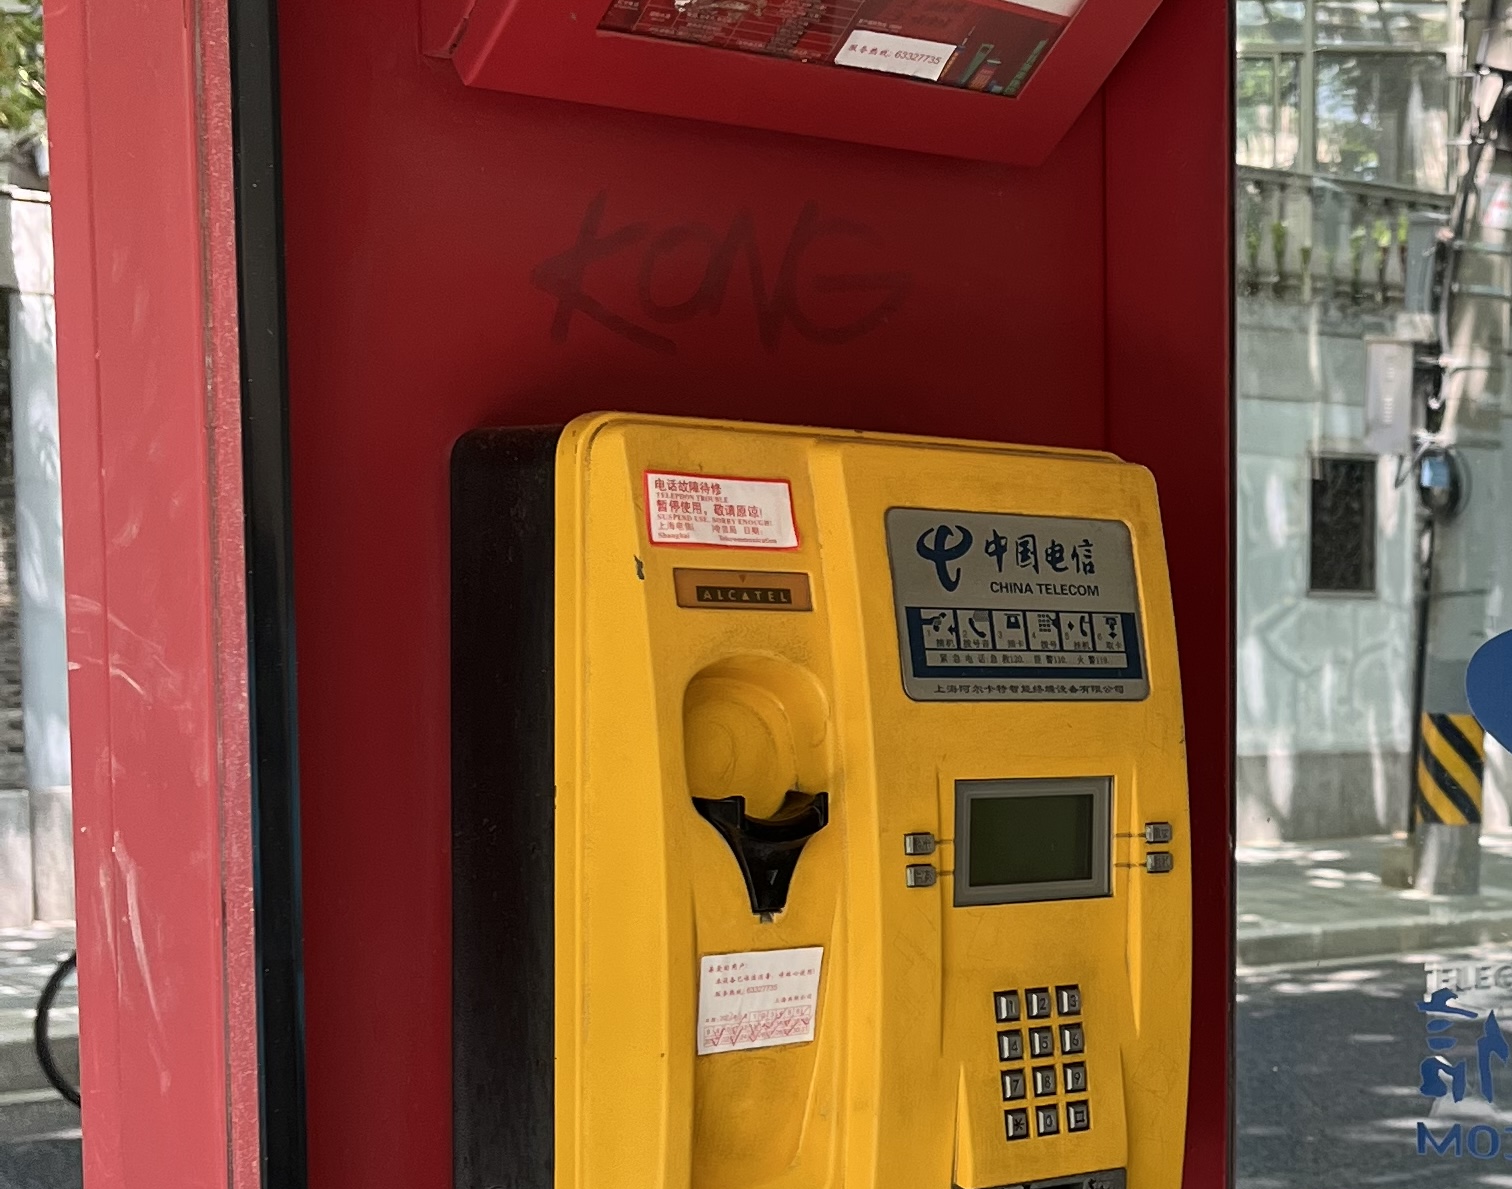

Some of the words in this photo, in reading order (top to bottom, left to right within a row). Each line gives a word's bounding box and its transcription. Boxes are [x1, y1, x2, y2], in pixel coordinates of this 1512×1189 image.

[894, 50, 942, 65] 63327735
[655, 477, 722, 495] 电话故障待修
[984, 529, 1096, 575] 中国电信
[703, 589, 788, 602] ALCATEL
[990, 581, 1033, 595] CHINA
[1036, 582, 1100, 597] TELECOM
